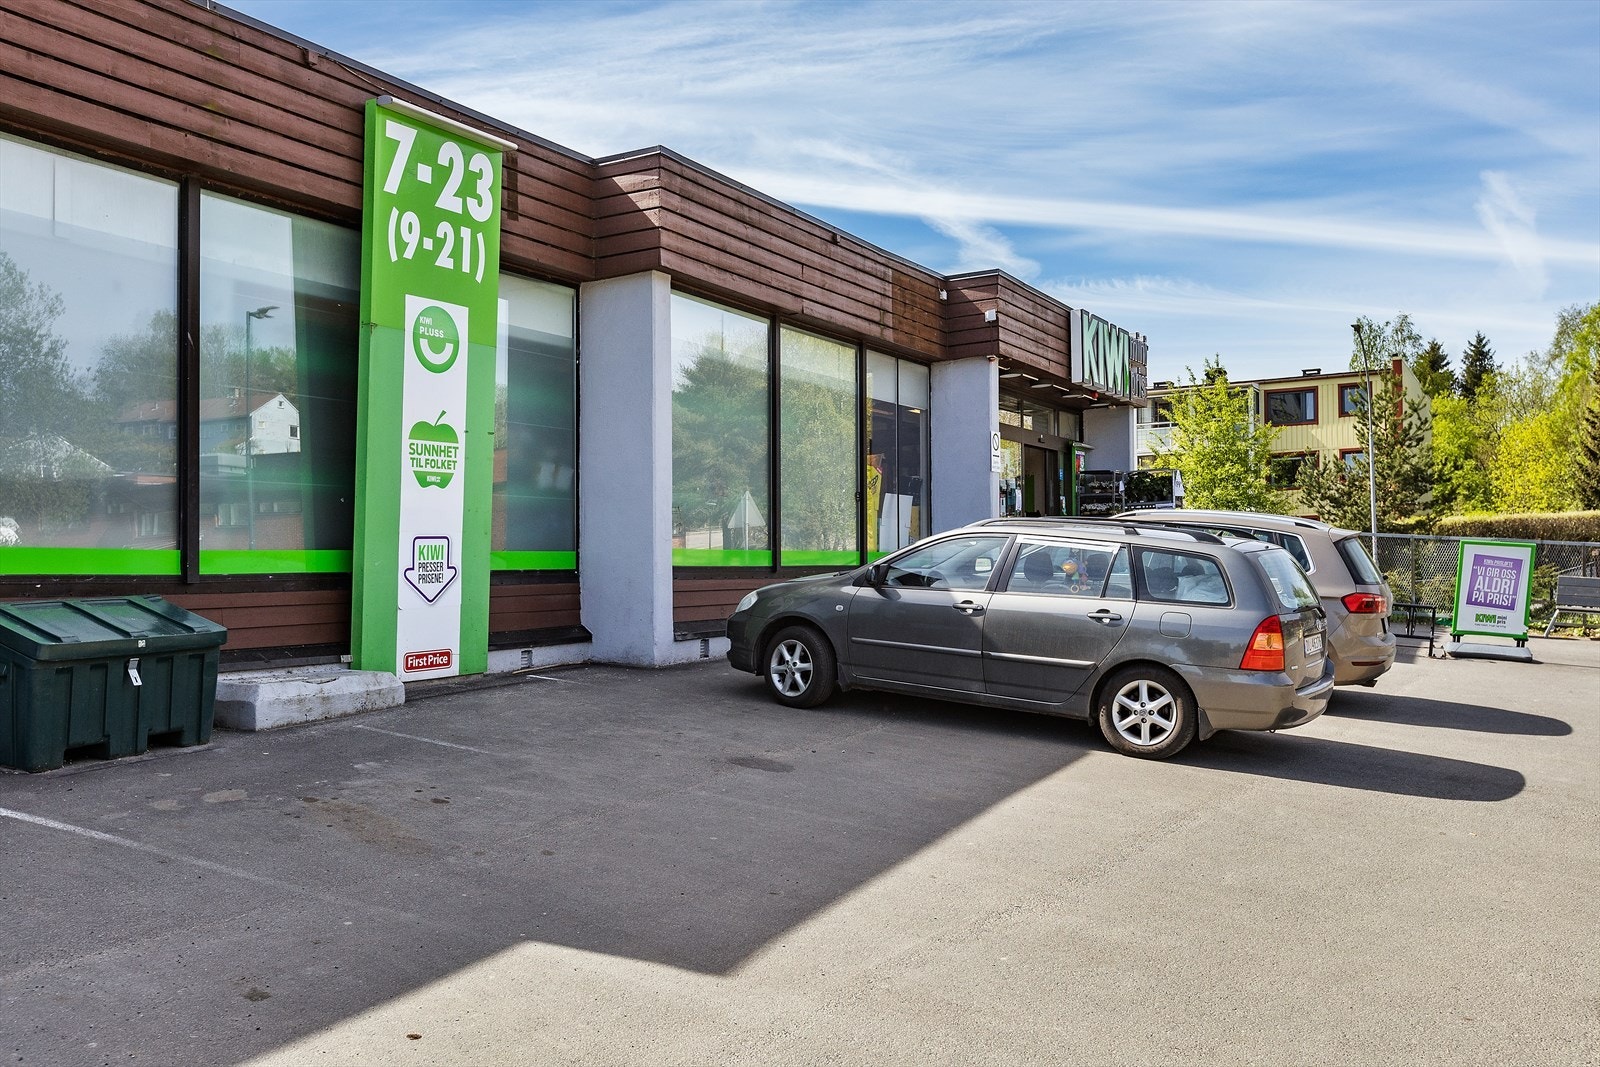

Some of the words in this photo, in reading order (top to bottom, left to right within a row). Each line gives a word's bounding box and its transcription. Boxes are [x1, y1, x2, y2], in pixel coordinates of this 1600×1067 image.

[384, 119, 494, 223] 7-23
[388, 206, 486, 284] (9-21)
[419, 325, 445, 338] PLUSS
[1081, 309, 1130, 399] KIWI
[408, 442, 459, 459] SUNNHET
[409, 457, 423, 468] TIL
[424, 458, 457, 471] FOLKET
[418, 544, 444, 561] KIWI
[417, 561, 444, 573] PRESSER
[1486, 567, 1500, 577] GIR
[1501, 568, 1517, 579] OSS
[417, 572, 444, 584] PRISENE!
[1474, 576, 1515, 594] ALDRI
[407, 655, 427, 668] First
[427, 653, 449, 666] Price
